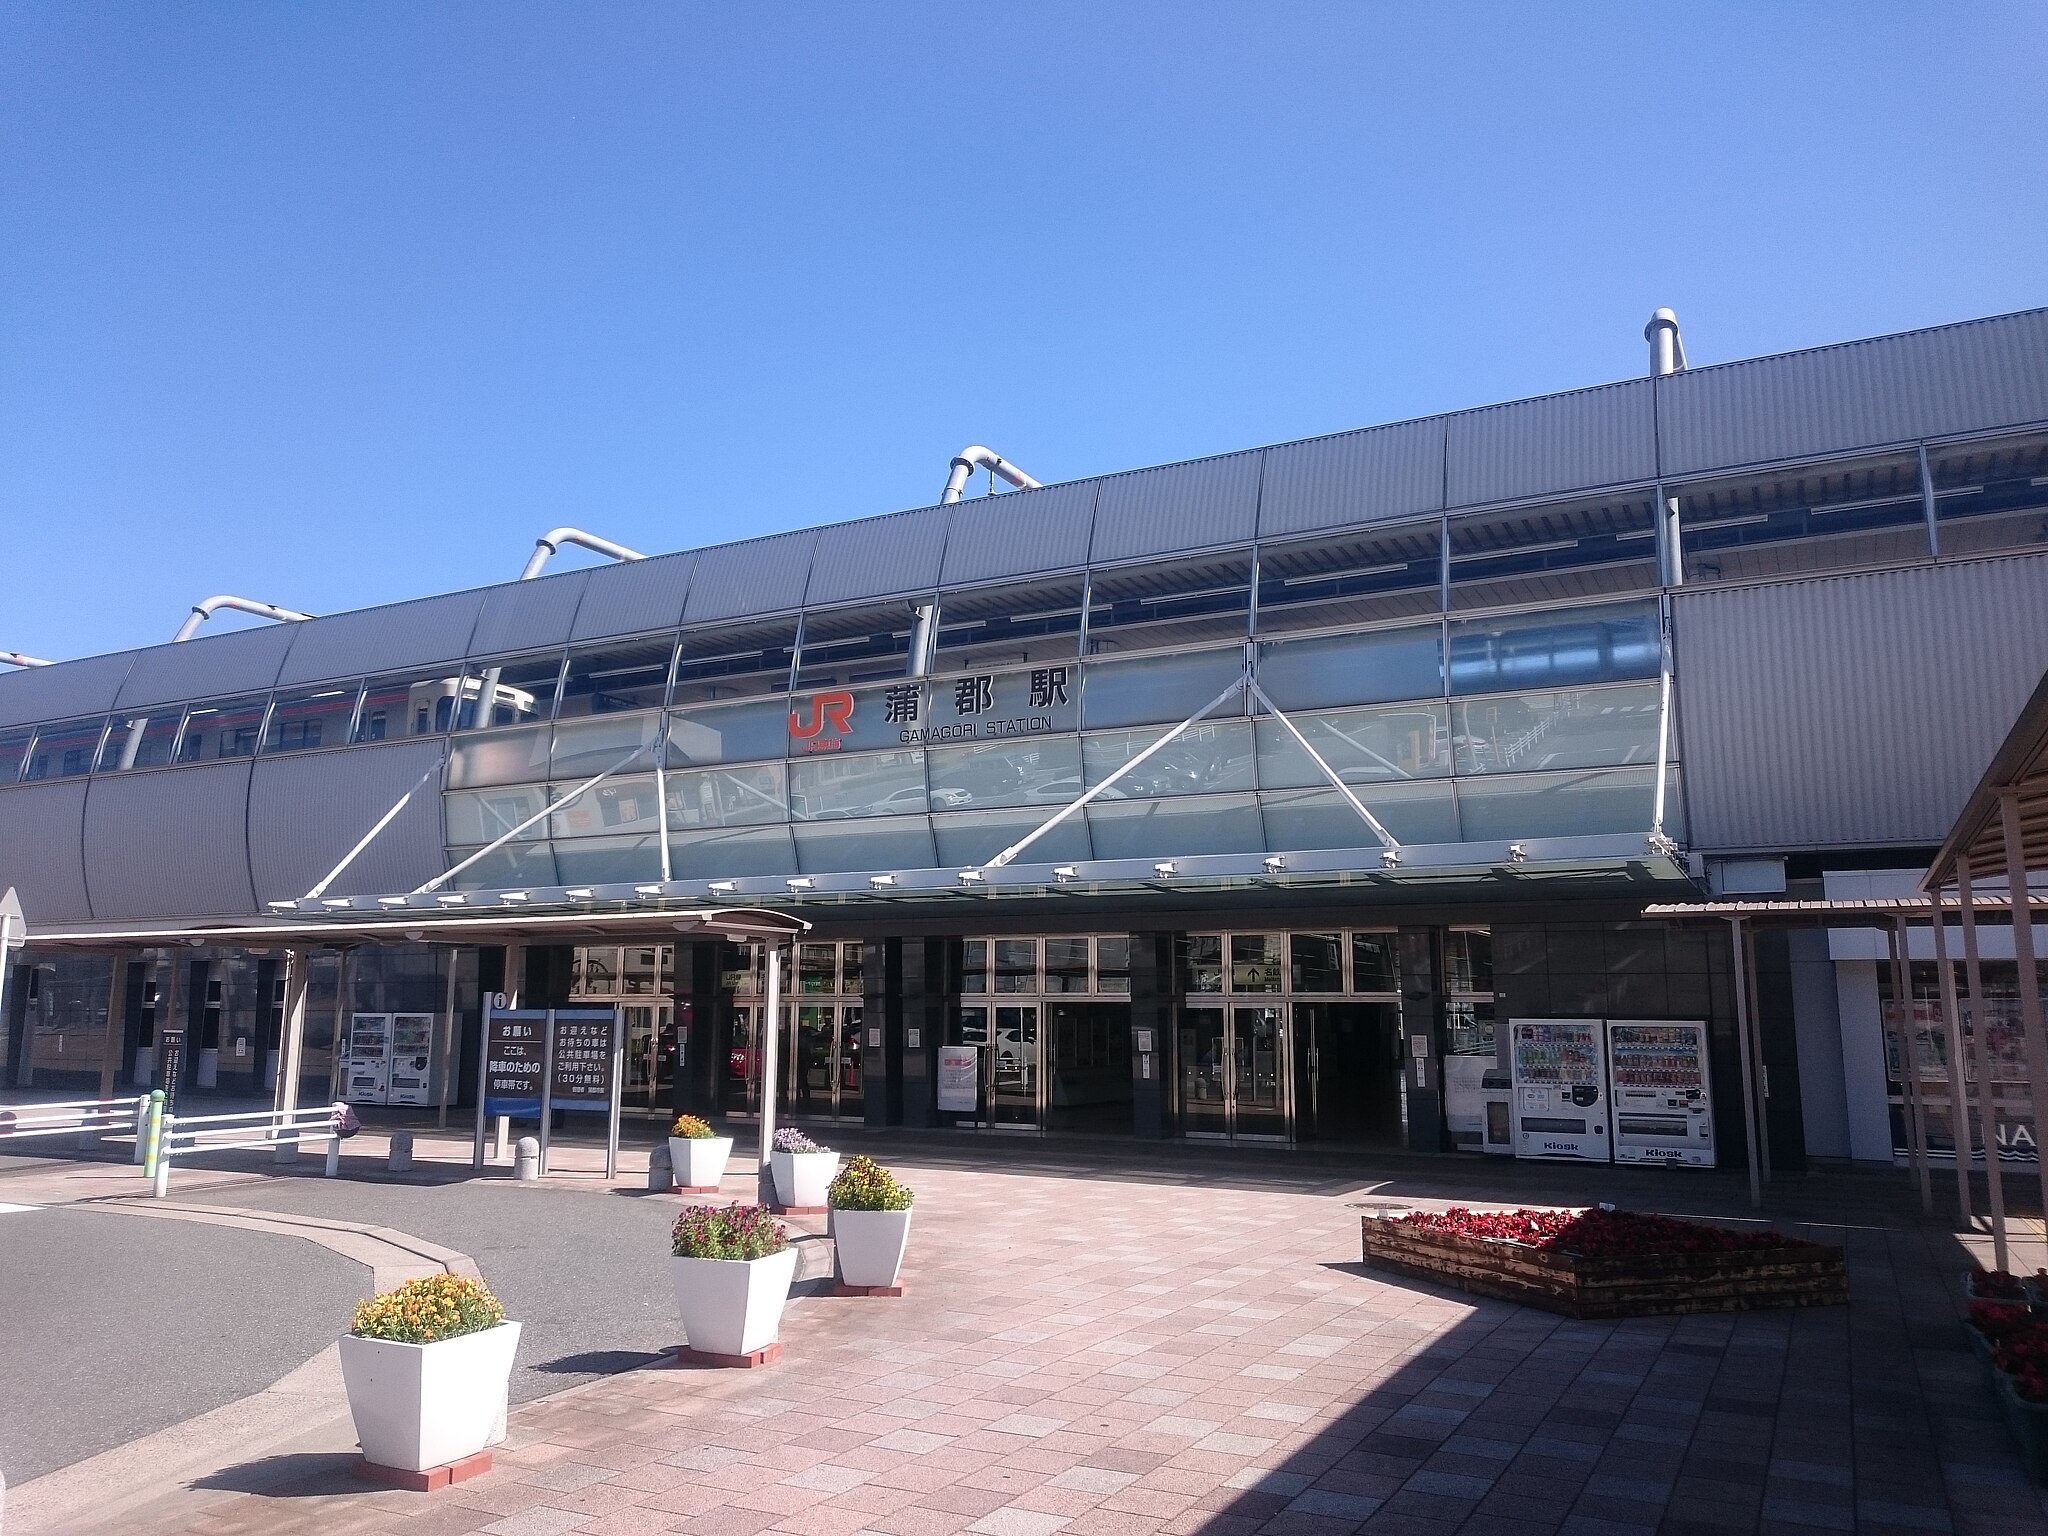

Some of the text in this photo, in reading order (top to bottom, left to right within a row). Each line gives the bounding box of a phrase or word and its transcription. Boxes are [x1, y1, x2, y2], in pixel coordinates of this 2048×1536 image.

[884, 667, 1069, 723] 蒲郡駅
[789, 691, 853, 737] JR
[987, 716, 1052, 734] STATION
[502, 1026, 532, 1036] お願い
[560, 1026, 608, 1035] お迎えなど
[560, 1039, 607, 1047] お待ちの車は
[504, 1046, 526, 1055] ここは、
[558, 1050, 606, 1059] 公共駐車場を
[490, 1061, 540, 1073] 降車のための
[558, 1062, 604, 1071] ご利用下さい。
[494, 1079, 532, 1090] 停車帯です。
[1981, 1123, 2037, 1147] NA
[1544, 1142, 1578, 1150] Kiosk
[1645, 1149, 1682, 1158] Kiosk
